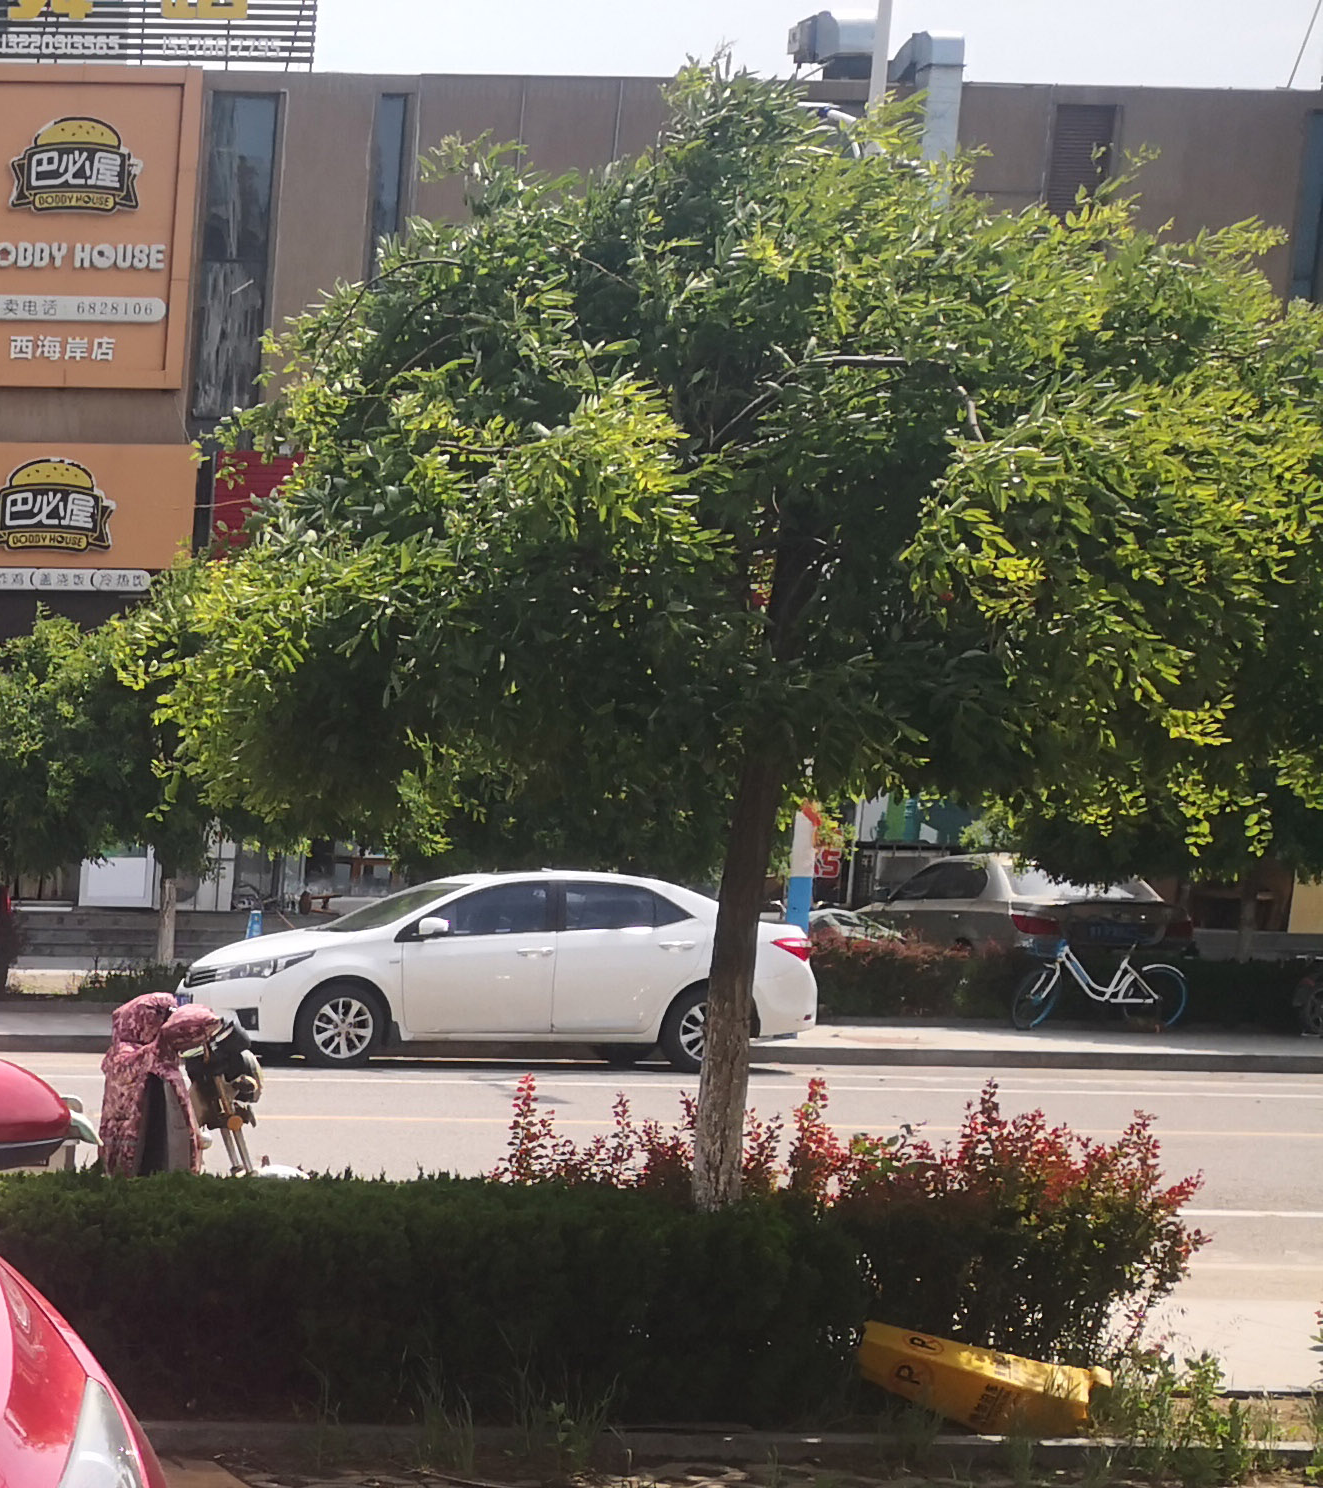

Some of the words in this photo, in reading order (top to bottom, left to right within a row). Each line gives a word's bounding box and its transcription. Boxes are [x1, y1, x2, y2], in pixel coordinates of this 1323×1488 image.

[30, 150, 122, 188] 巴必屋
[76, 194, 112, 207] HOUSE
[73, 242, 167, 270] HOUSE
[76, 301, 154, 317] 6828106
[9, 334, 116, 361] 西海岸店
[5, 491, 97, 529] 巴必屋
[49, 534, 84, 547] HOUSE
